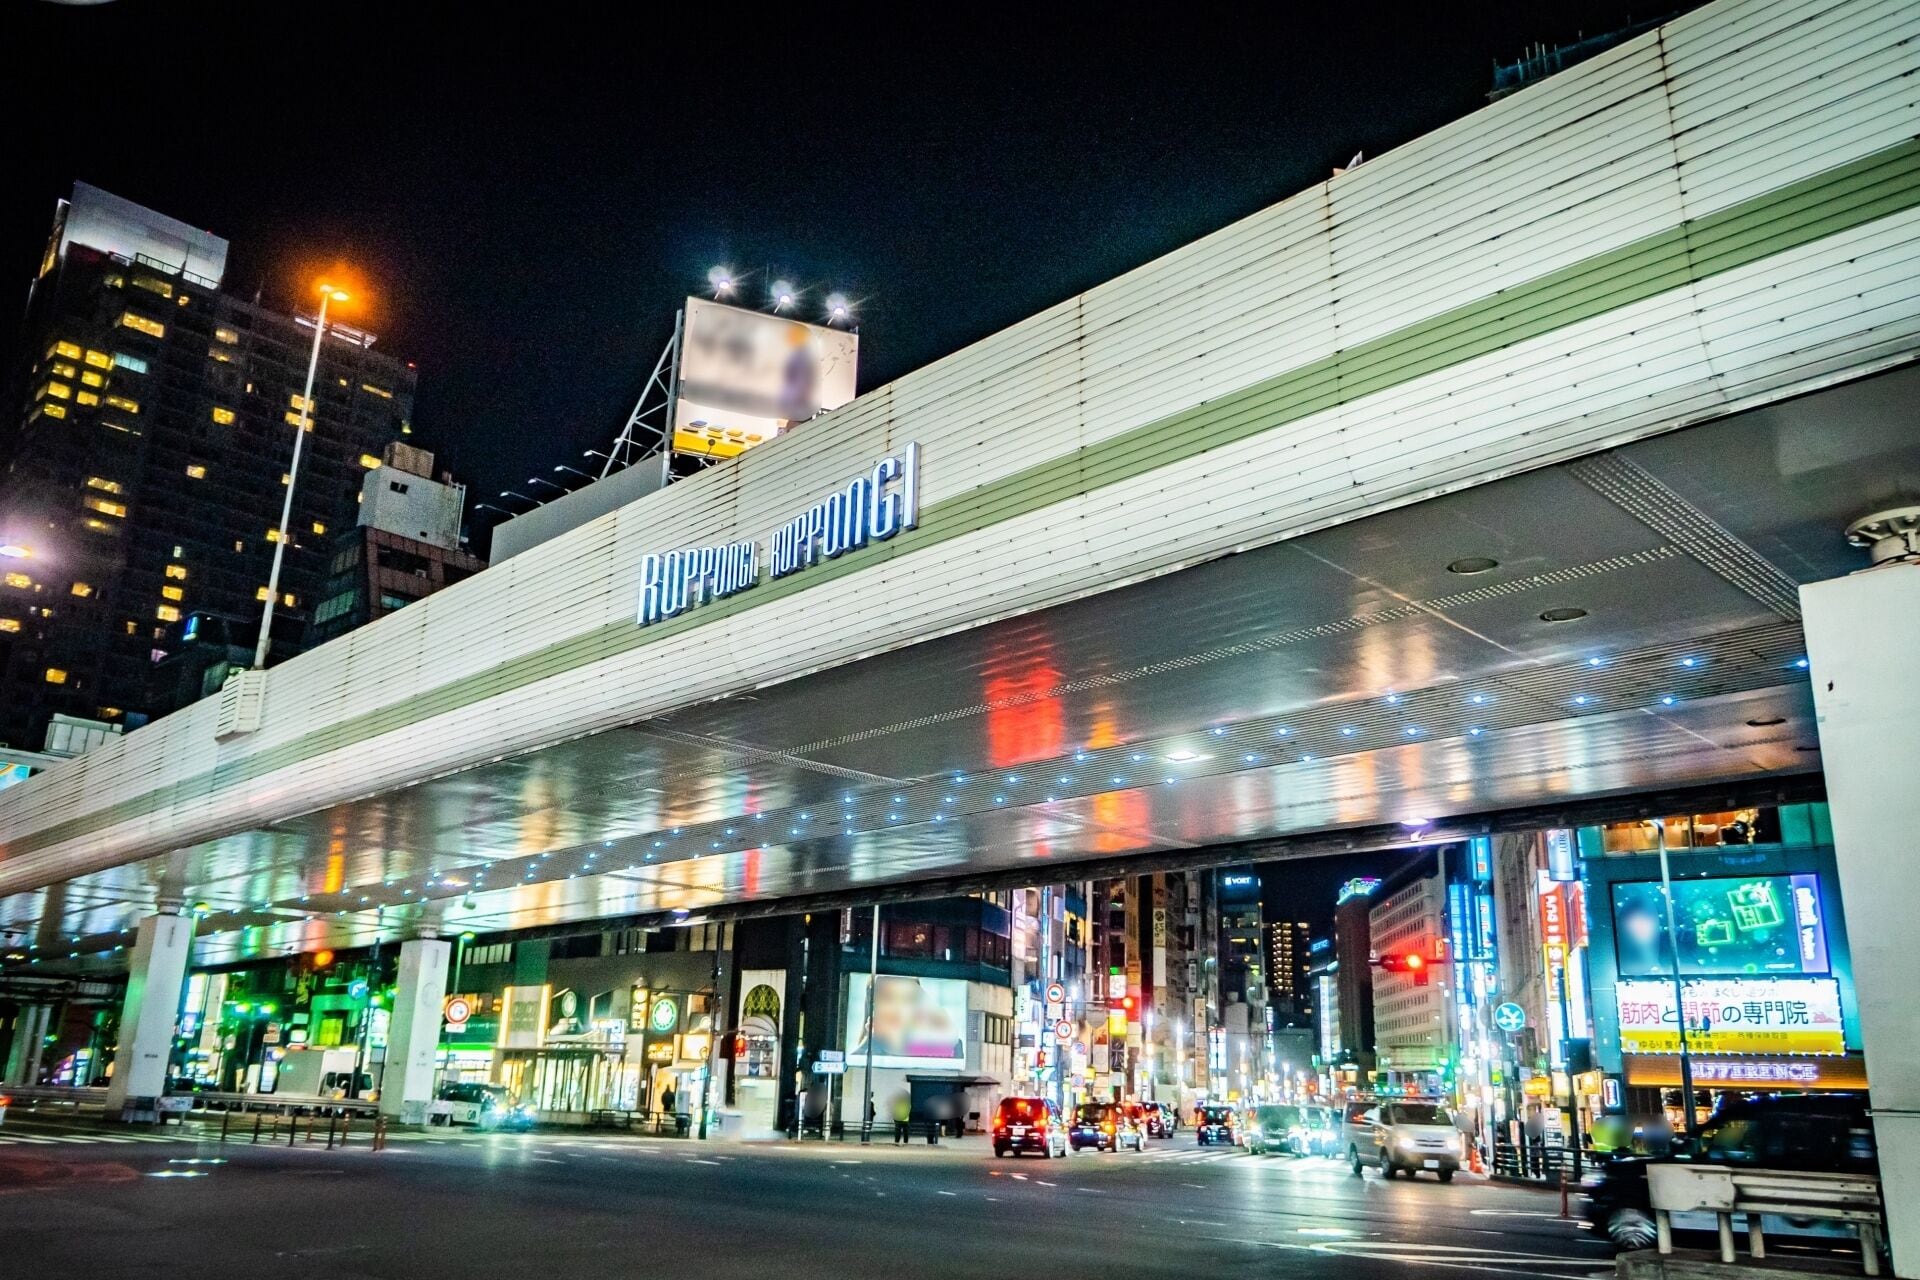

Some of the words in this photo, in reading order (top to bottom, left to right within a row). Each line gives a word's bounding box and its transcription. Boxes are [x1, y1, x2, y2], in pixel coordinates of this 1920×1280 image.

[637, 541, 760, 626] ROPPONGI
[769, 441, 921, 579] ROPPONGI
[1621, 1000, 1809, 1025] 筋肉と関節の専門院
[1690, 1062, 1818, 1081] DIFFERENCE
